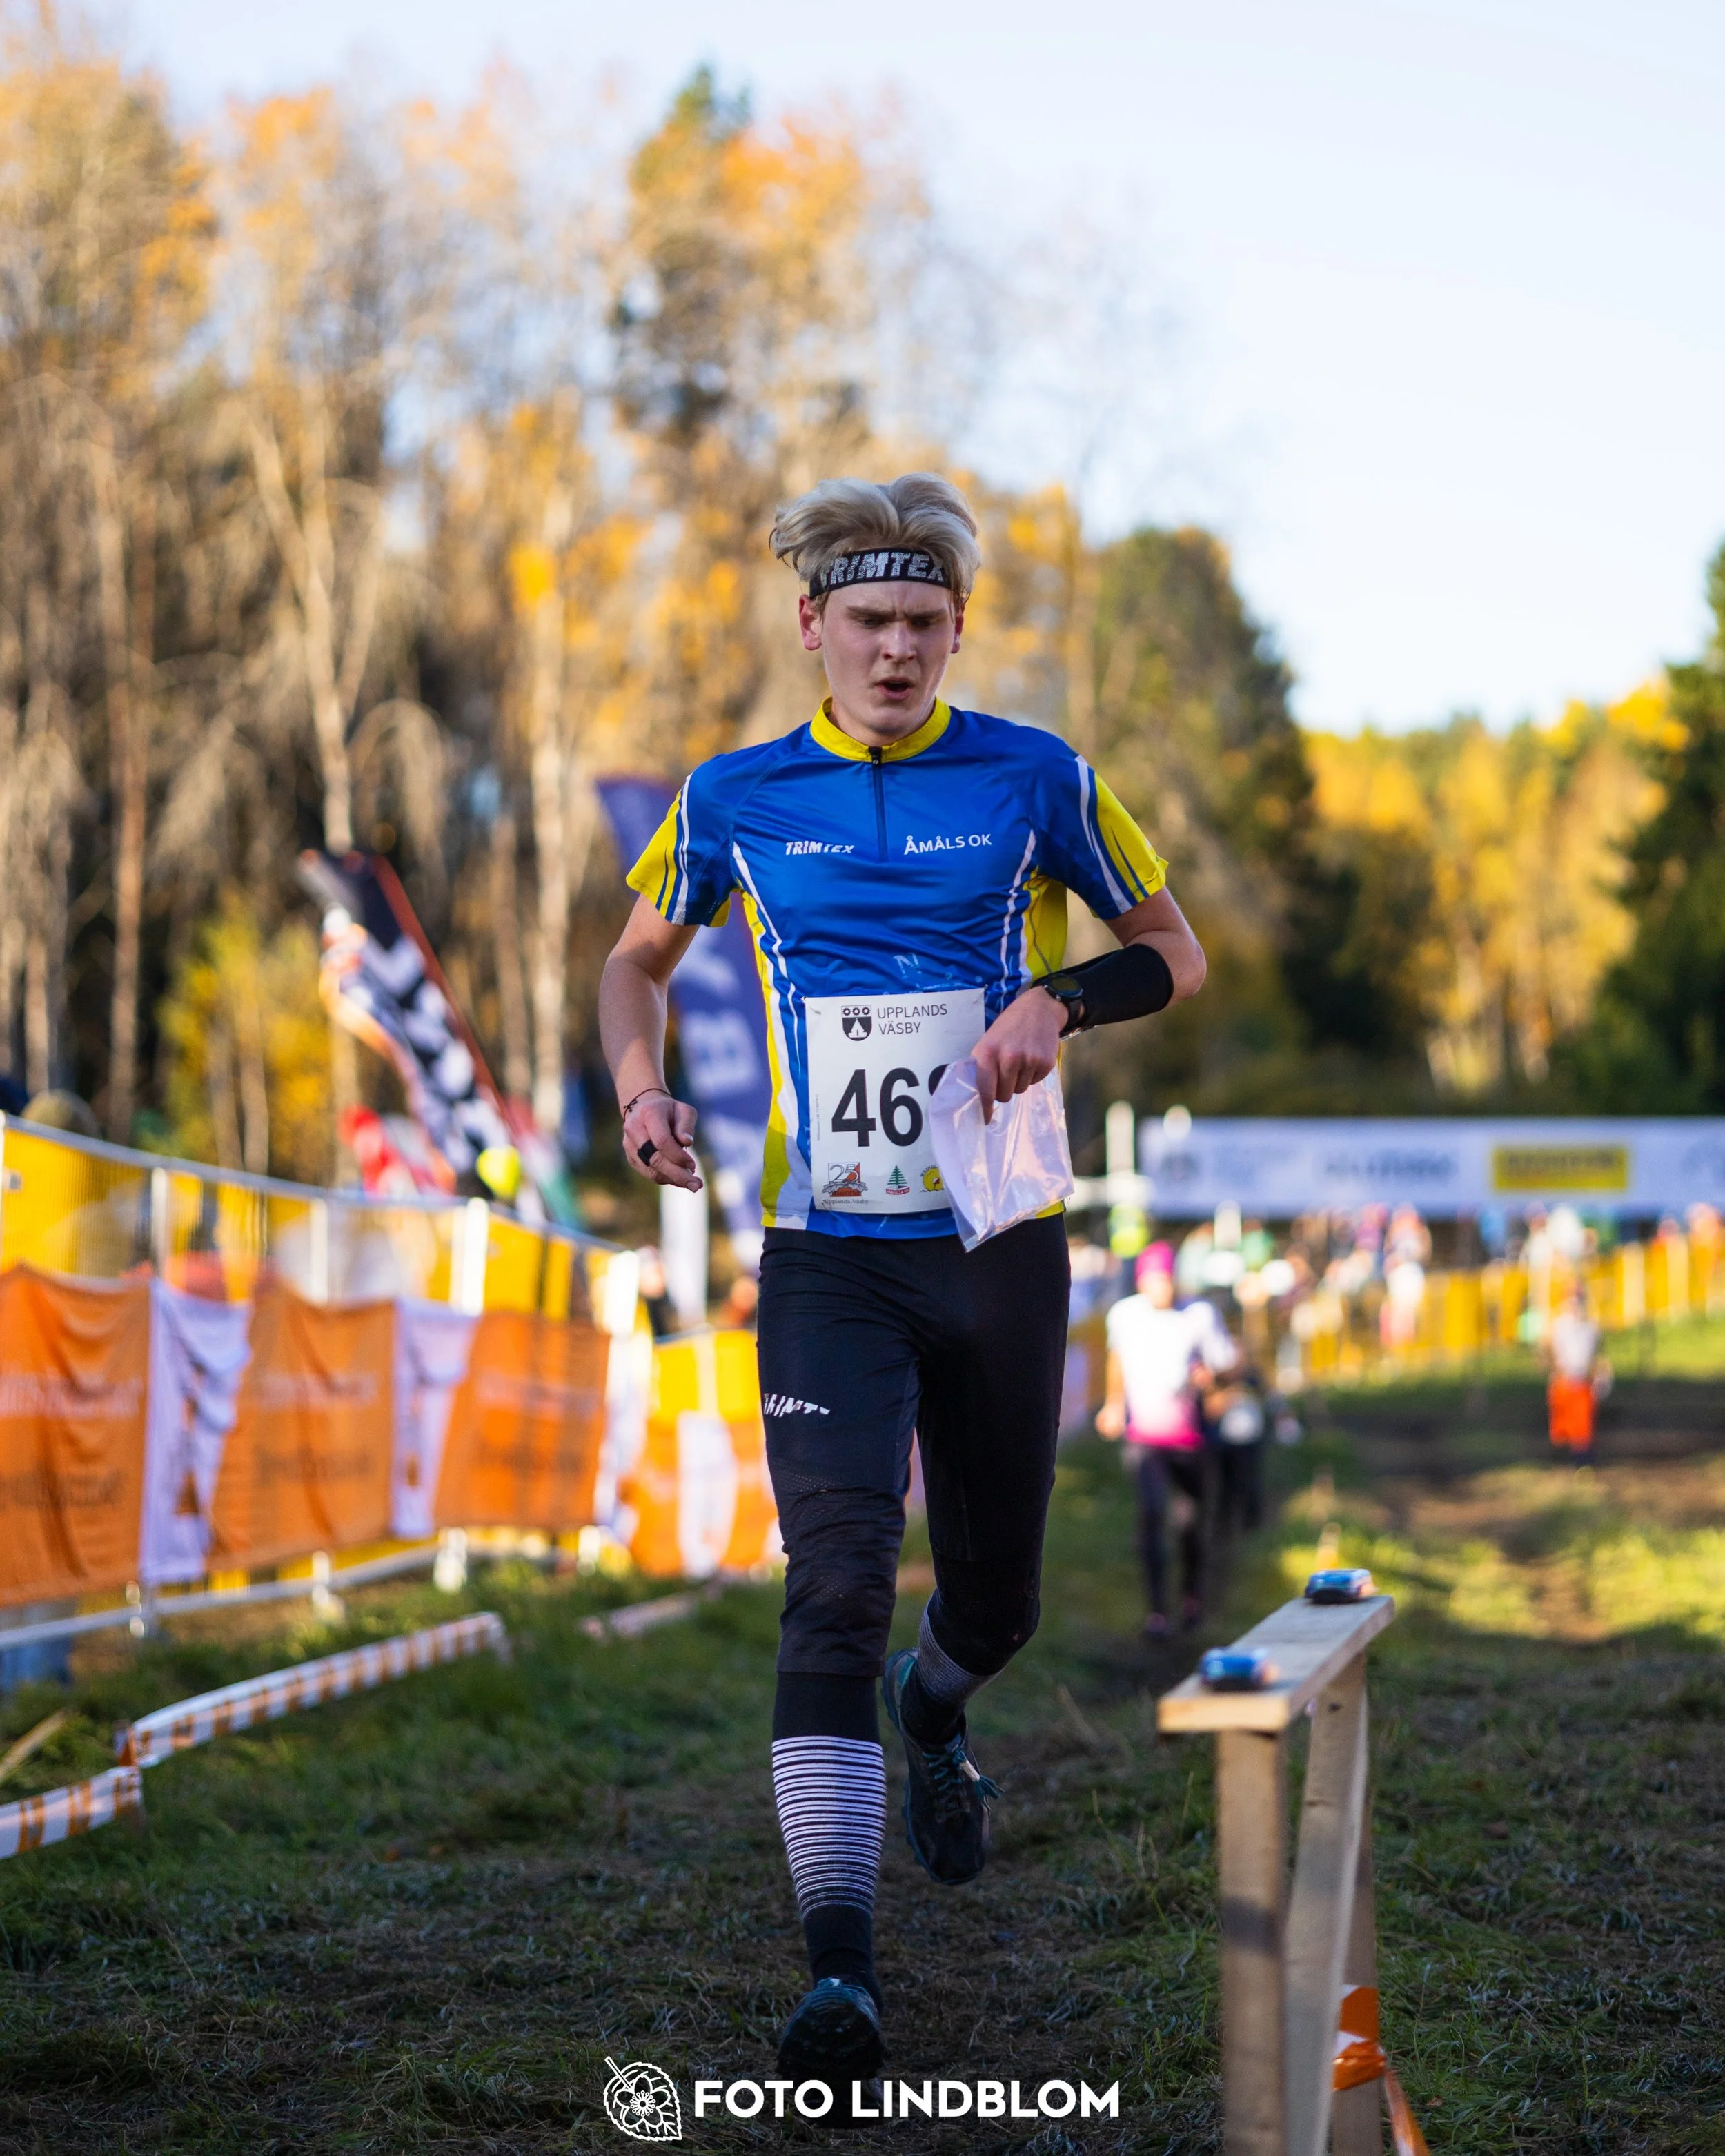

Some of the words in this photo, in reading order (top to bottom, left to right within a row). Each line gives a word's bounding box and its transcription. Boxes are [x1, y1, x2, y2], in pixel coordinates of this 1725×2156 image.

[785, 840, 855, 856] TRIMTEX
[904, 835, 965, 855] ÅMÅLS
[968, 833, 992, 847] OK
[877, 1003, 947, 1019] UPPLANDS
[878, 1020, 921, 1035] VÄSBY
[830, 1164, 859, 1183] 25
